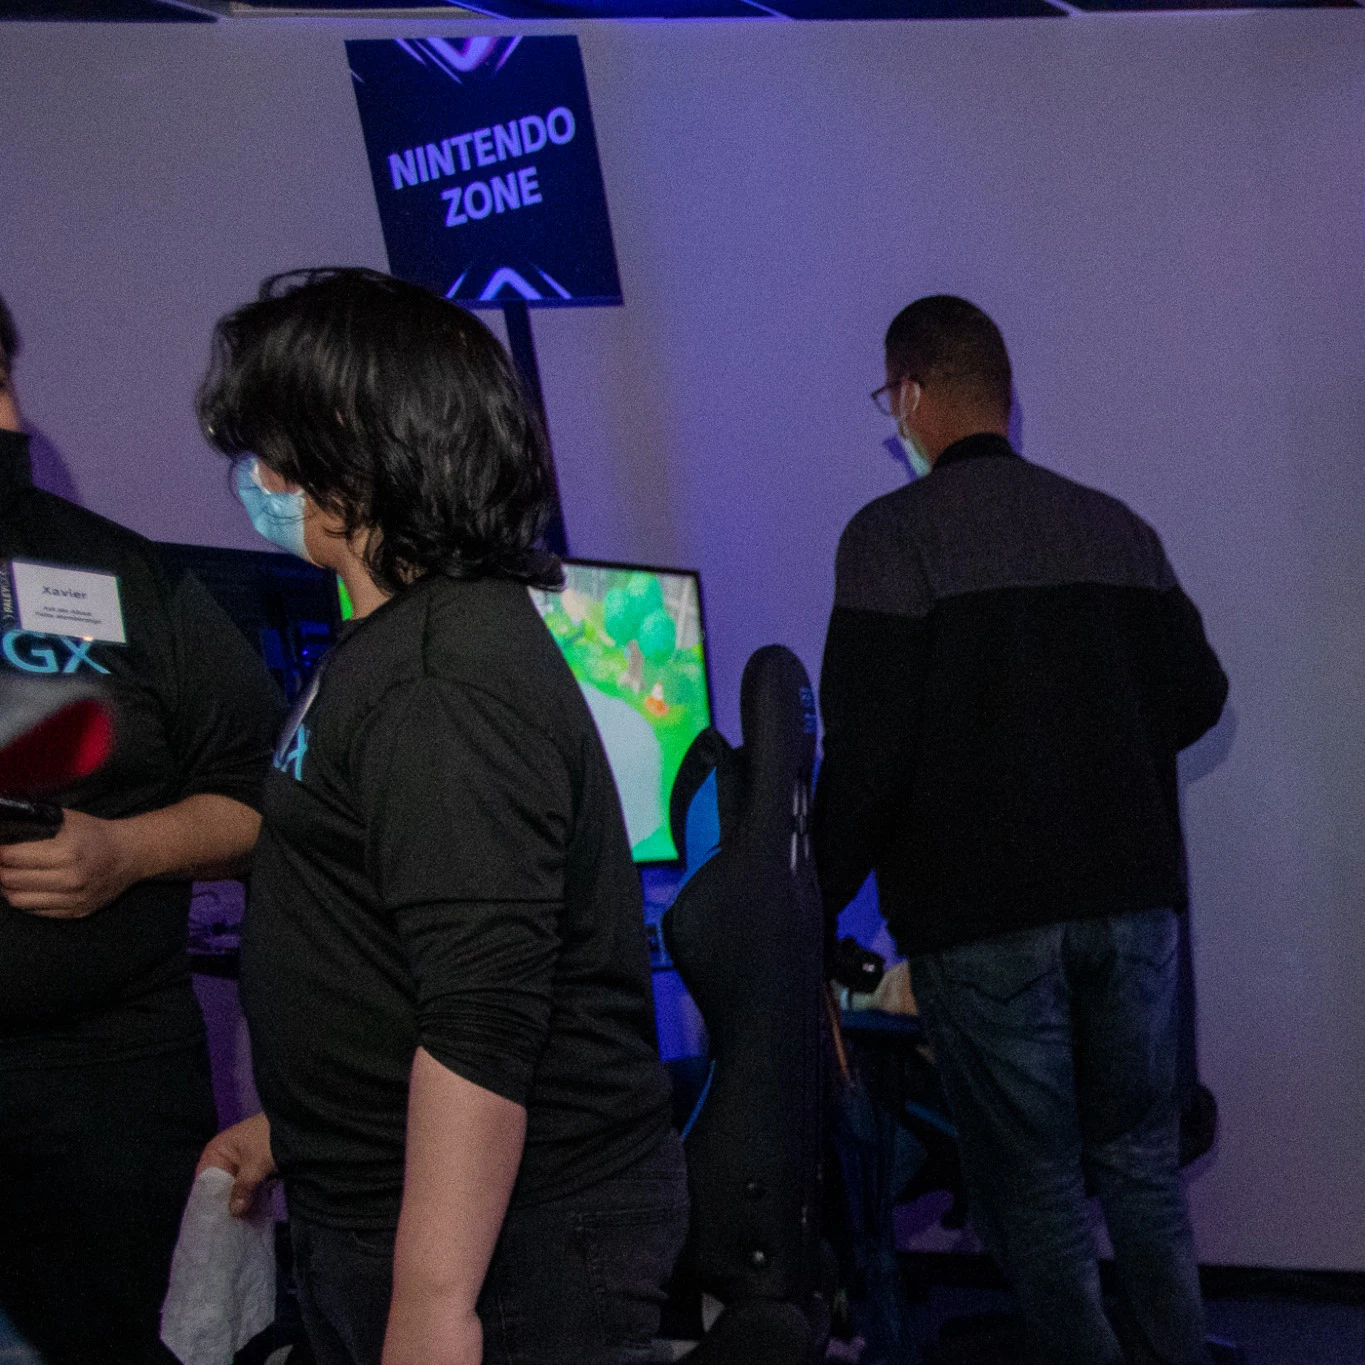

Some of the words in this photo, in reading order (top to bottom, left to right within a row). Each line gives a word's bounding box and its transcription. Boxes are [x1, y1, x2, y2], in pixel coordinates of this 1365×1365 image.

[387, 106, 575, 190] NINTENDO
[441, 166, 543, 228] ZONE
[42, 585, 87, 600] Xavier
[3, 629, 112, 674] GX
